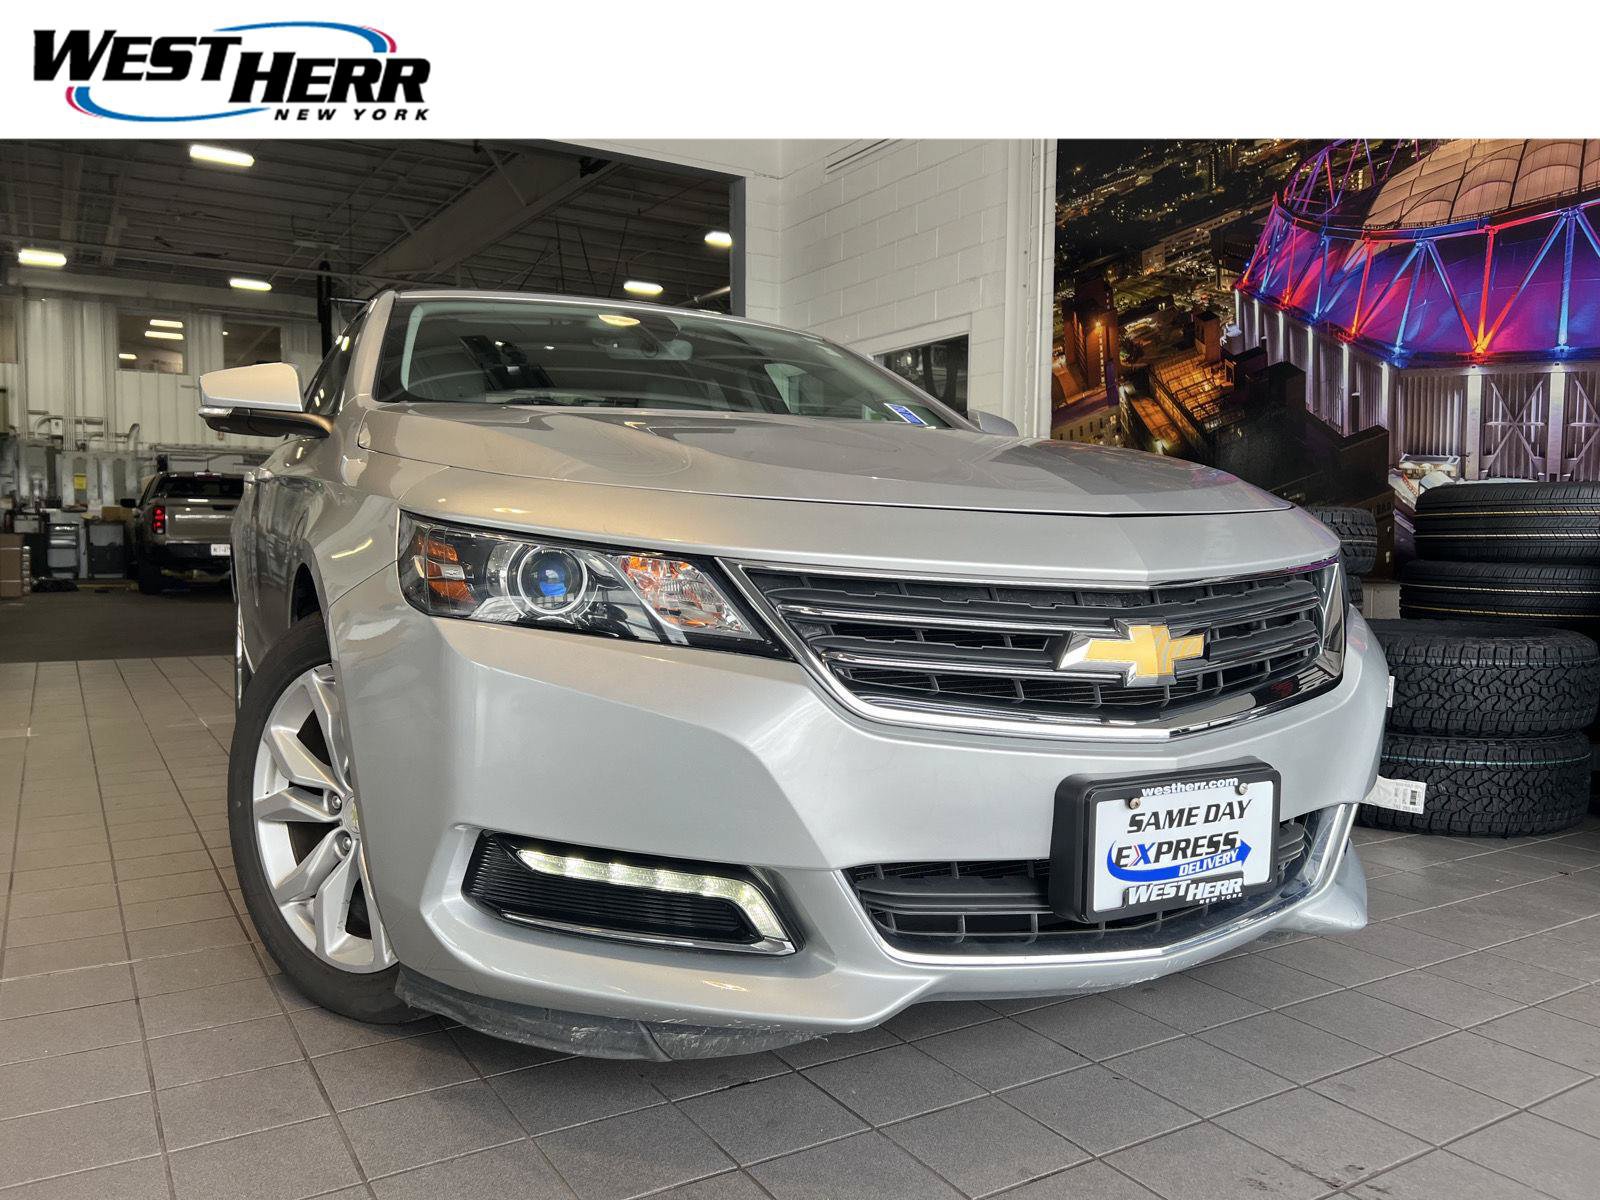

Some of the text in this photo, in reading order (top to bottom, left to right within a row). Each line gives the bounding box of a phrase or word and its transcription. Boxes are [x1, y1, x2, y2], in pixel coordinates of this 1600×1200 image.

[1141, 777, 1239, 797] westherr.com
[1127, 799, 1253, 834] SAME DAY
[1114, 831, 1239, 868] EXPRESS
[1178, 848, 1239, 877] DELIVERY
